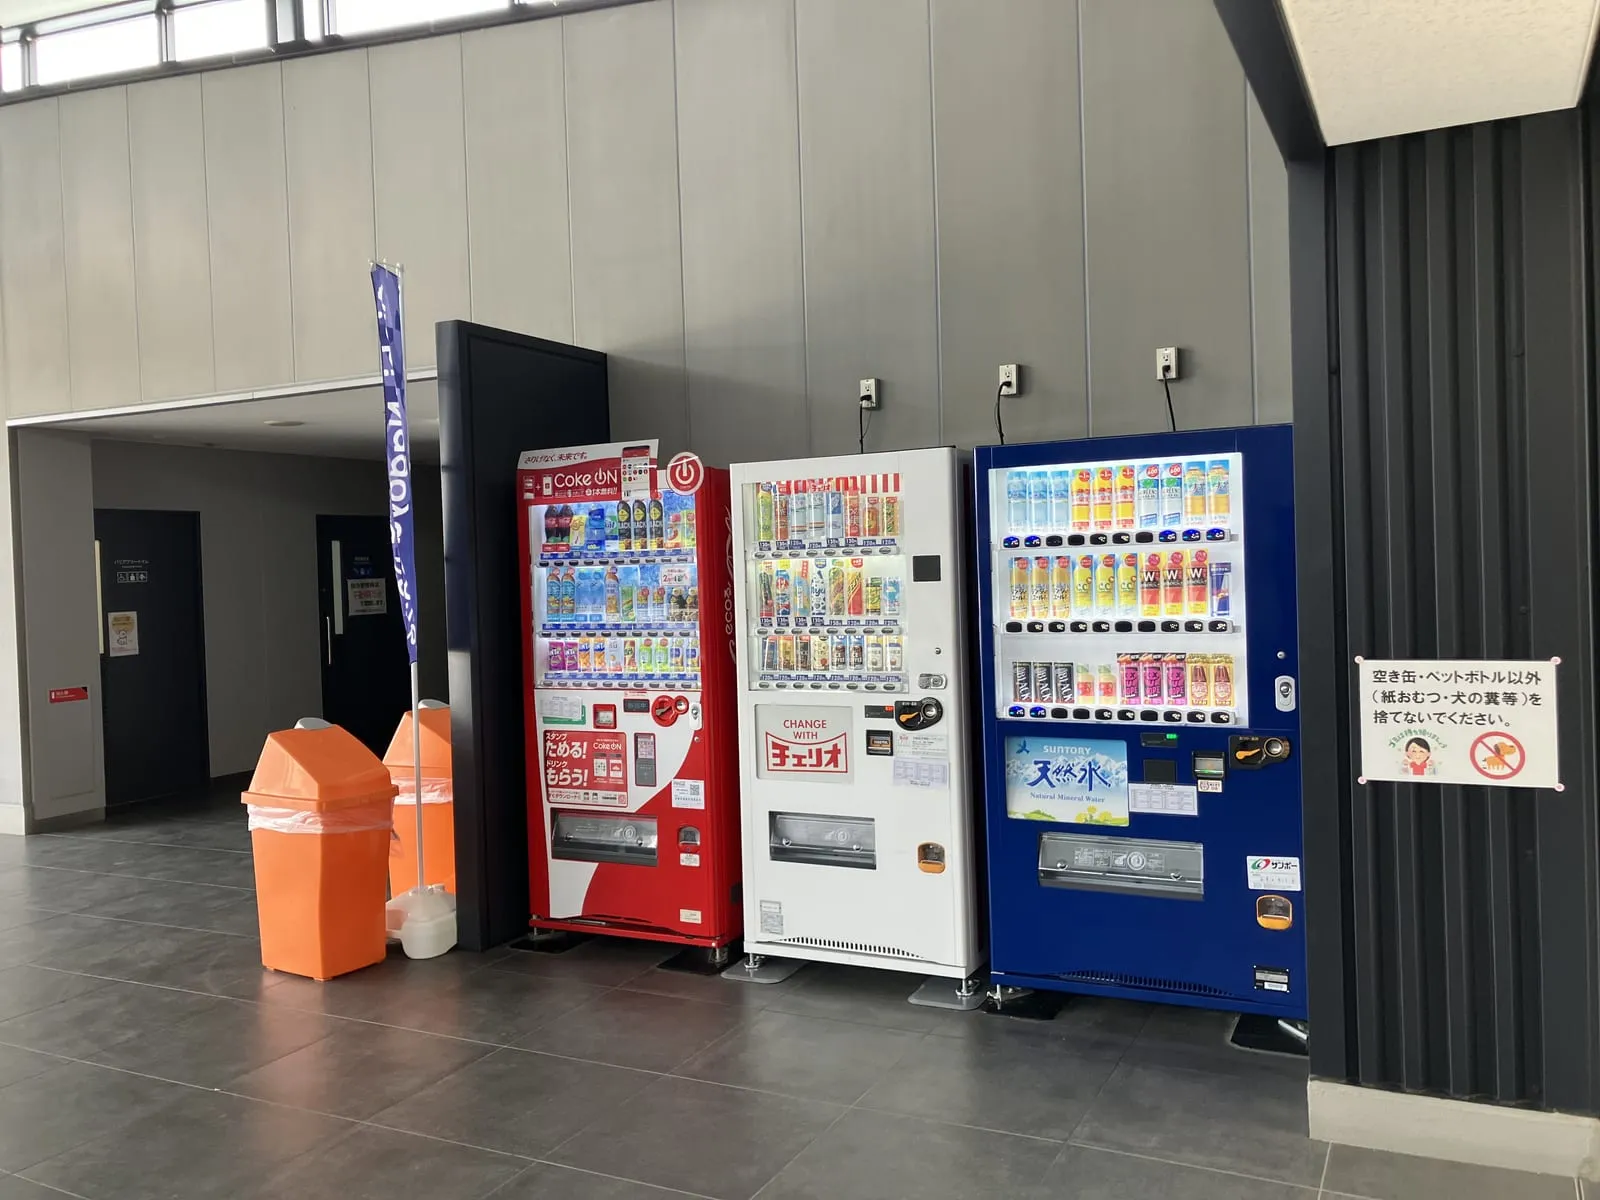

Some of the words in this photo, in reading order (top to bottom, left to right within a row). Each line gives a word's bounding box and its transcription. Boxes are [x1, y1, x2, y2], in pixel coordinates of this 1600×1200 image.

[554, 472, 592, 488] Coke
[594, 467, 618, 485] ON
[1372, 669, 1541, 686] 空き缶・ペットボトル以外
[783, 719, 827, 729] CHANGE
[1373, 710, 1510, 727] 捨てないでください。
[546, 732, 568, 740] スタンプ
[793, 731, 818, 740] WITH
[771, 740, 841, 768] チェリオ
[1043, 745, 1092, 755] SUNTORY
[547, 760, 568, 768] ドリンク
[1027, 760, 1111, 792] 天然水
[1030, 792, 1055, 800] Natural
[1057, 793, 1083, 801] Mineral
[1085, 795, 1105, 803] Water
